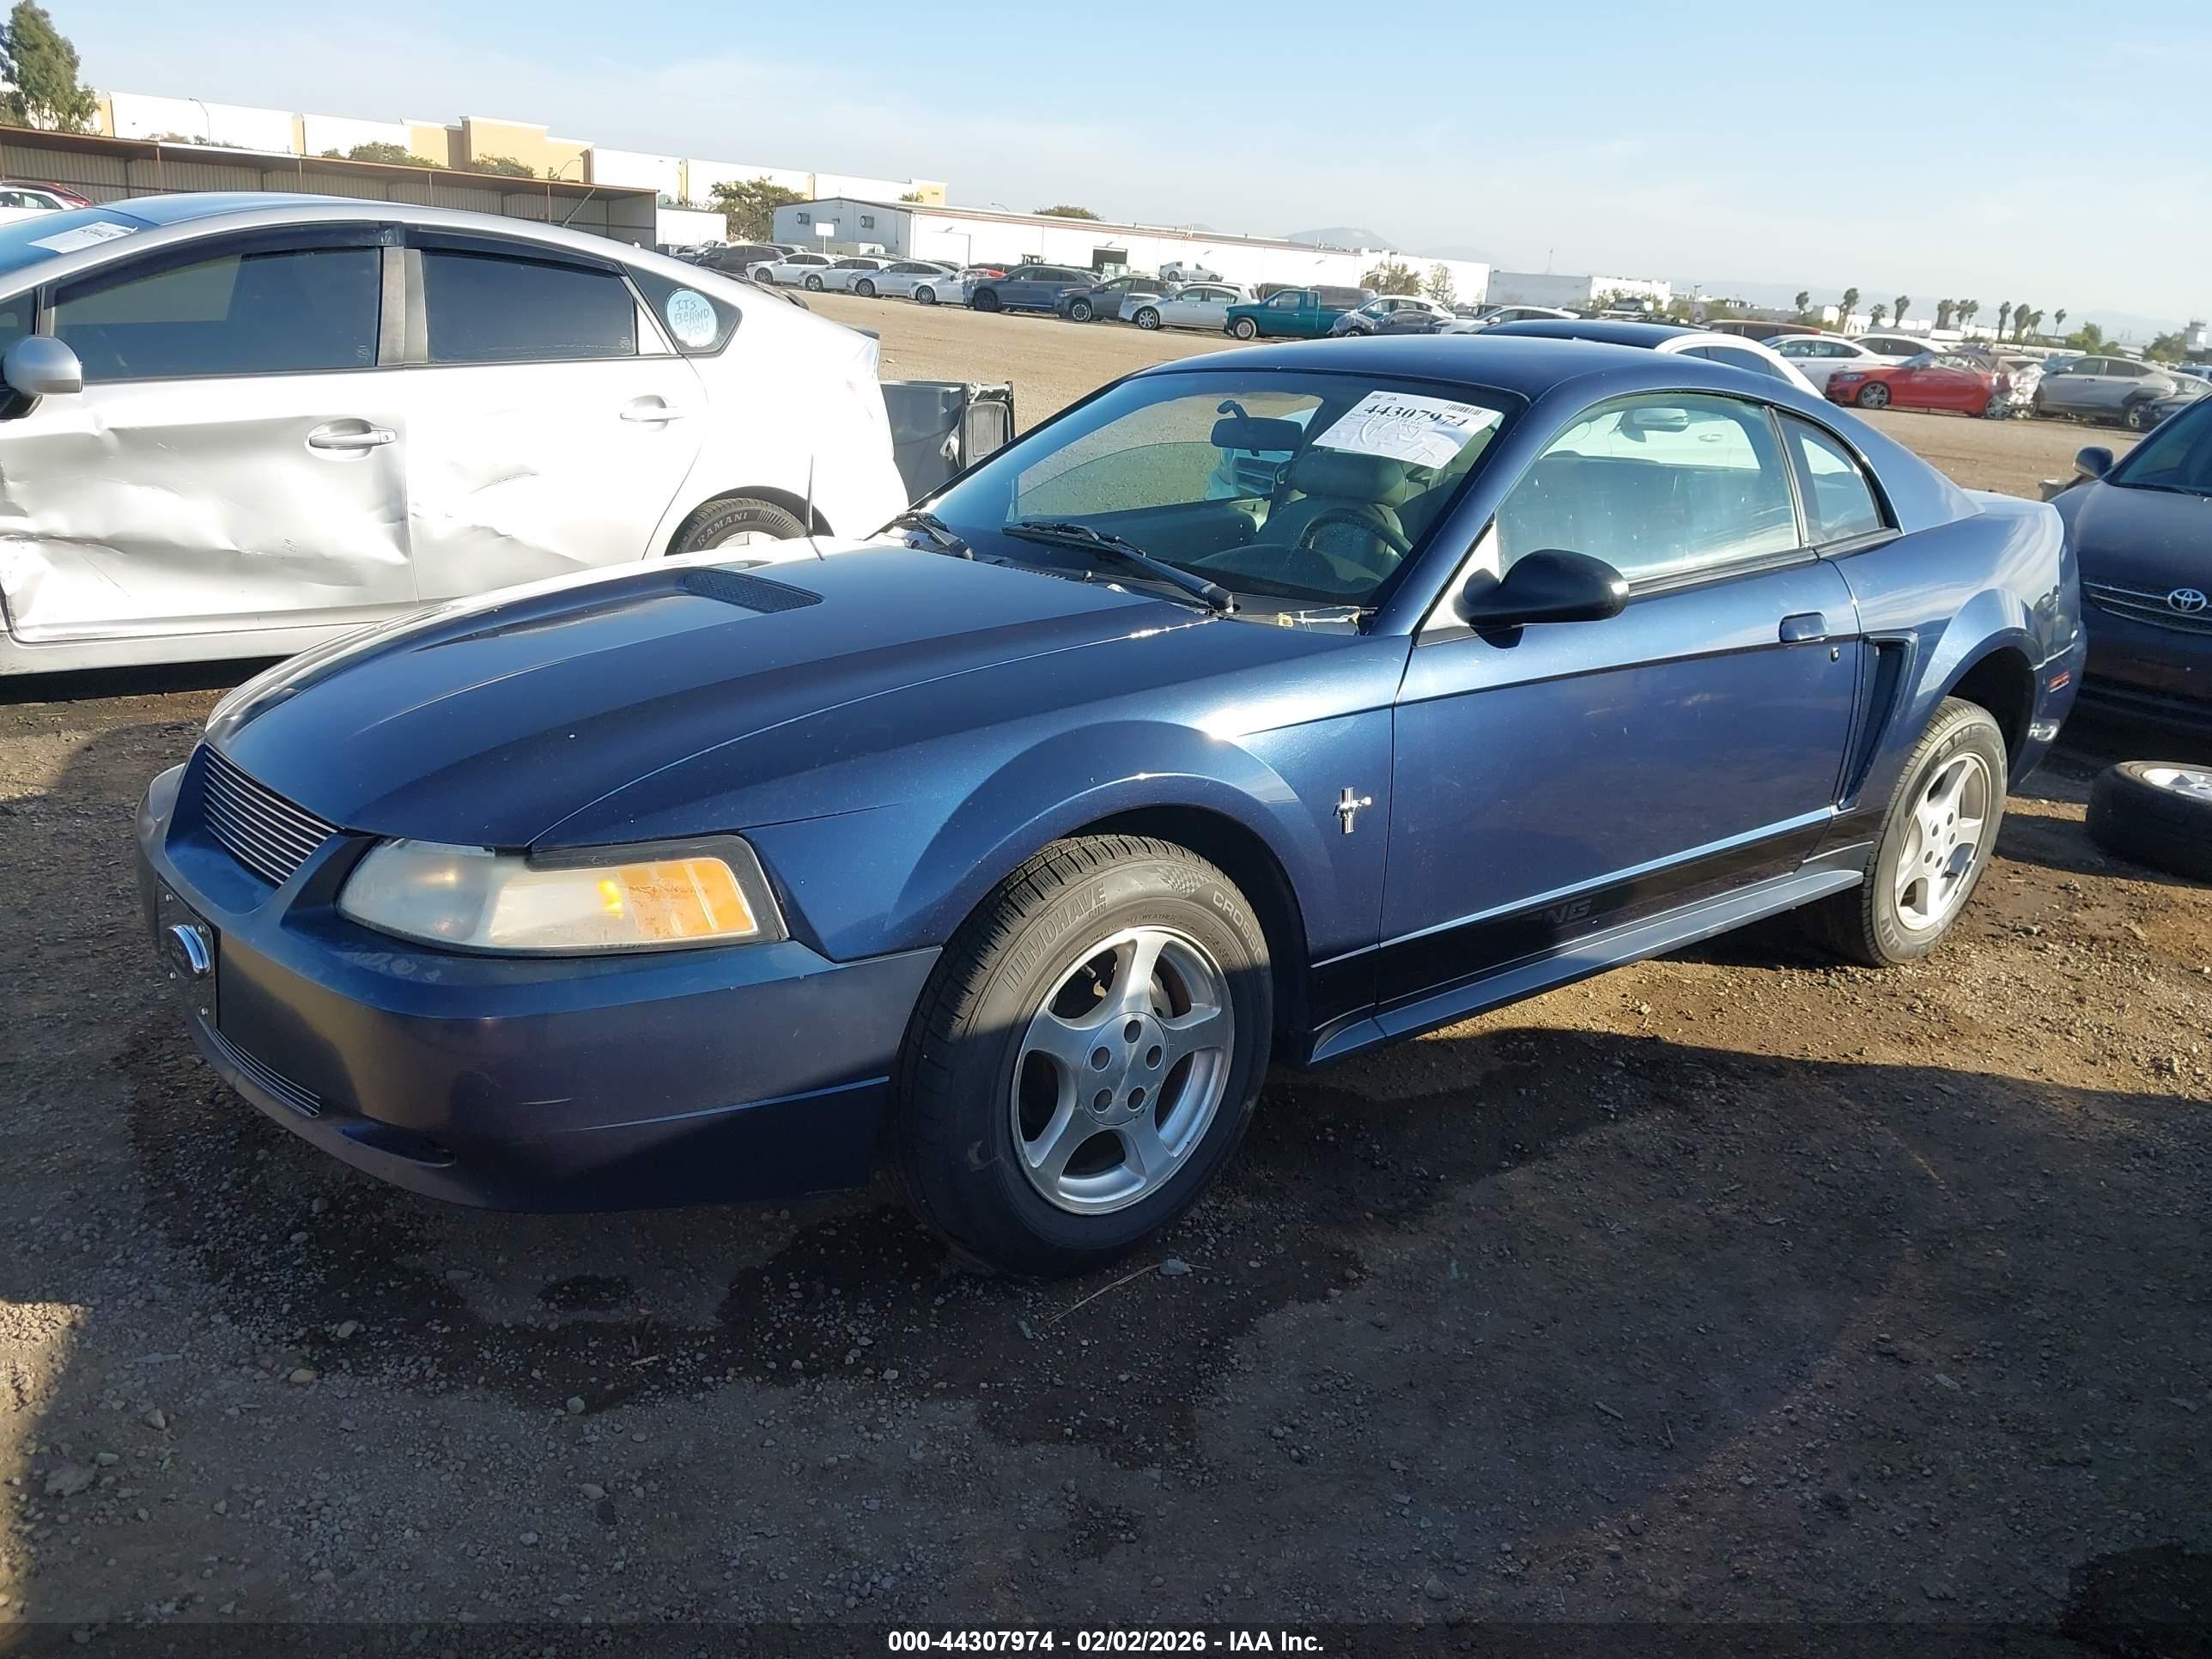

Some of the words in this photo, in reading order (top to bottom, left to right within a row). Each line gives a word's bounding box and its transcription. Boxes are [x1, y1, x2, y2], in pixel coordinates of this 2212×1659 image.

[686, 320, 708, 337] YOU
[1364, 404, 1470, 427] 44307974
[1023, 881, 1108, 965] MOHAVE
